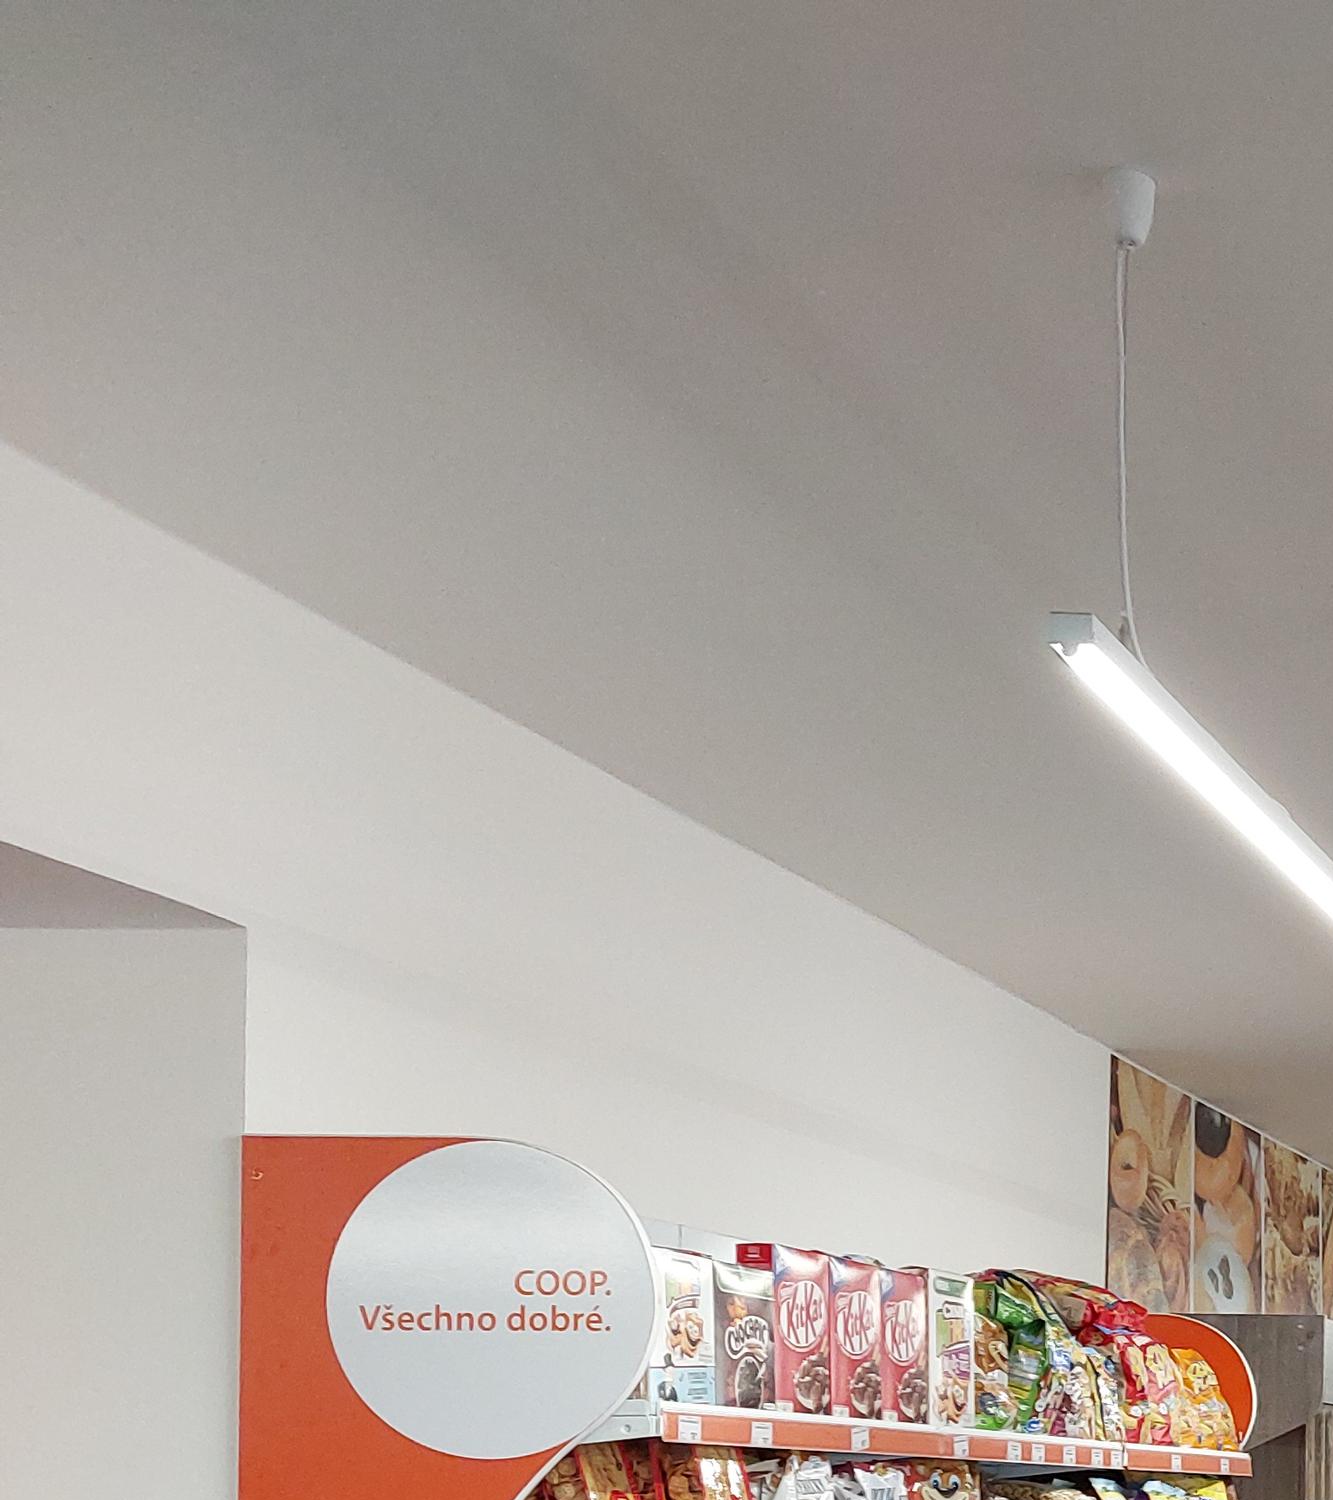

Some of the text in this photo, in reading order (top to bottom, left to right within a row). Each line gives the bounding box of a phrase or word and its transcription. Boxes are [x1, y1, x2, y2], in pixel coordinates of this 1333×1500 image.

[514, 1270, 612, 1298] COOP.
[359, 1305, 612, 1333] Všechno dobré.
